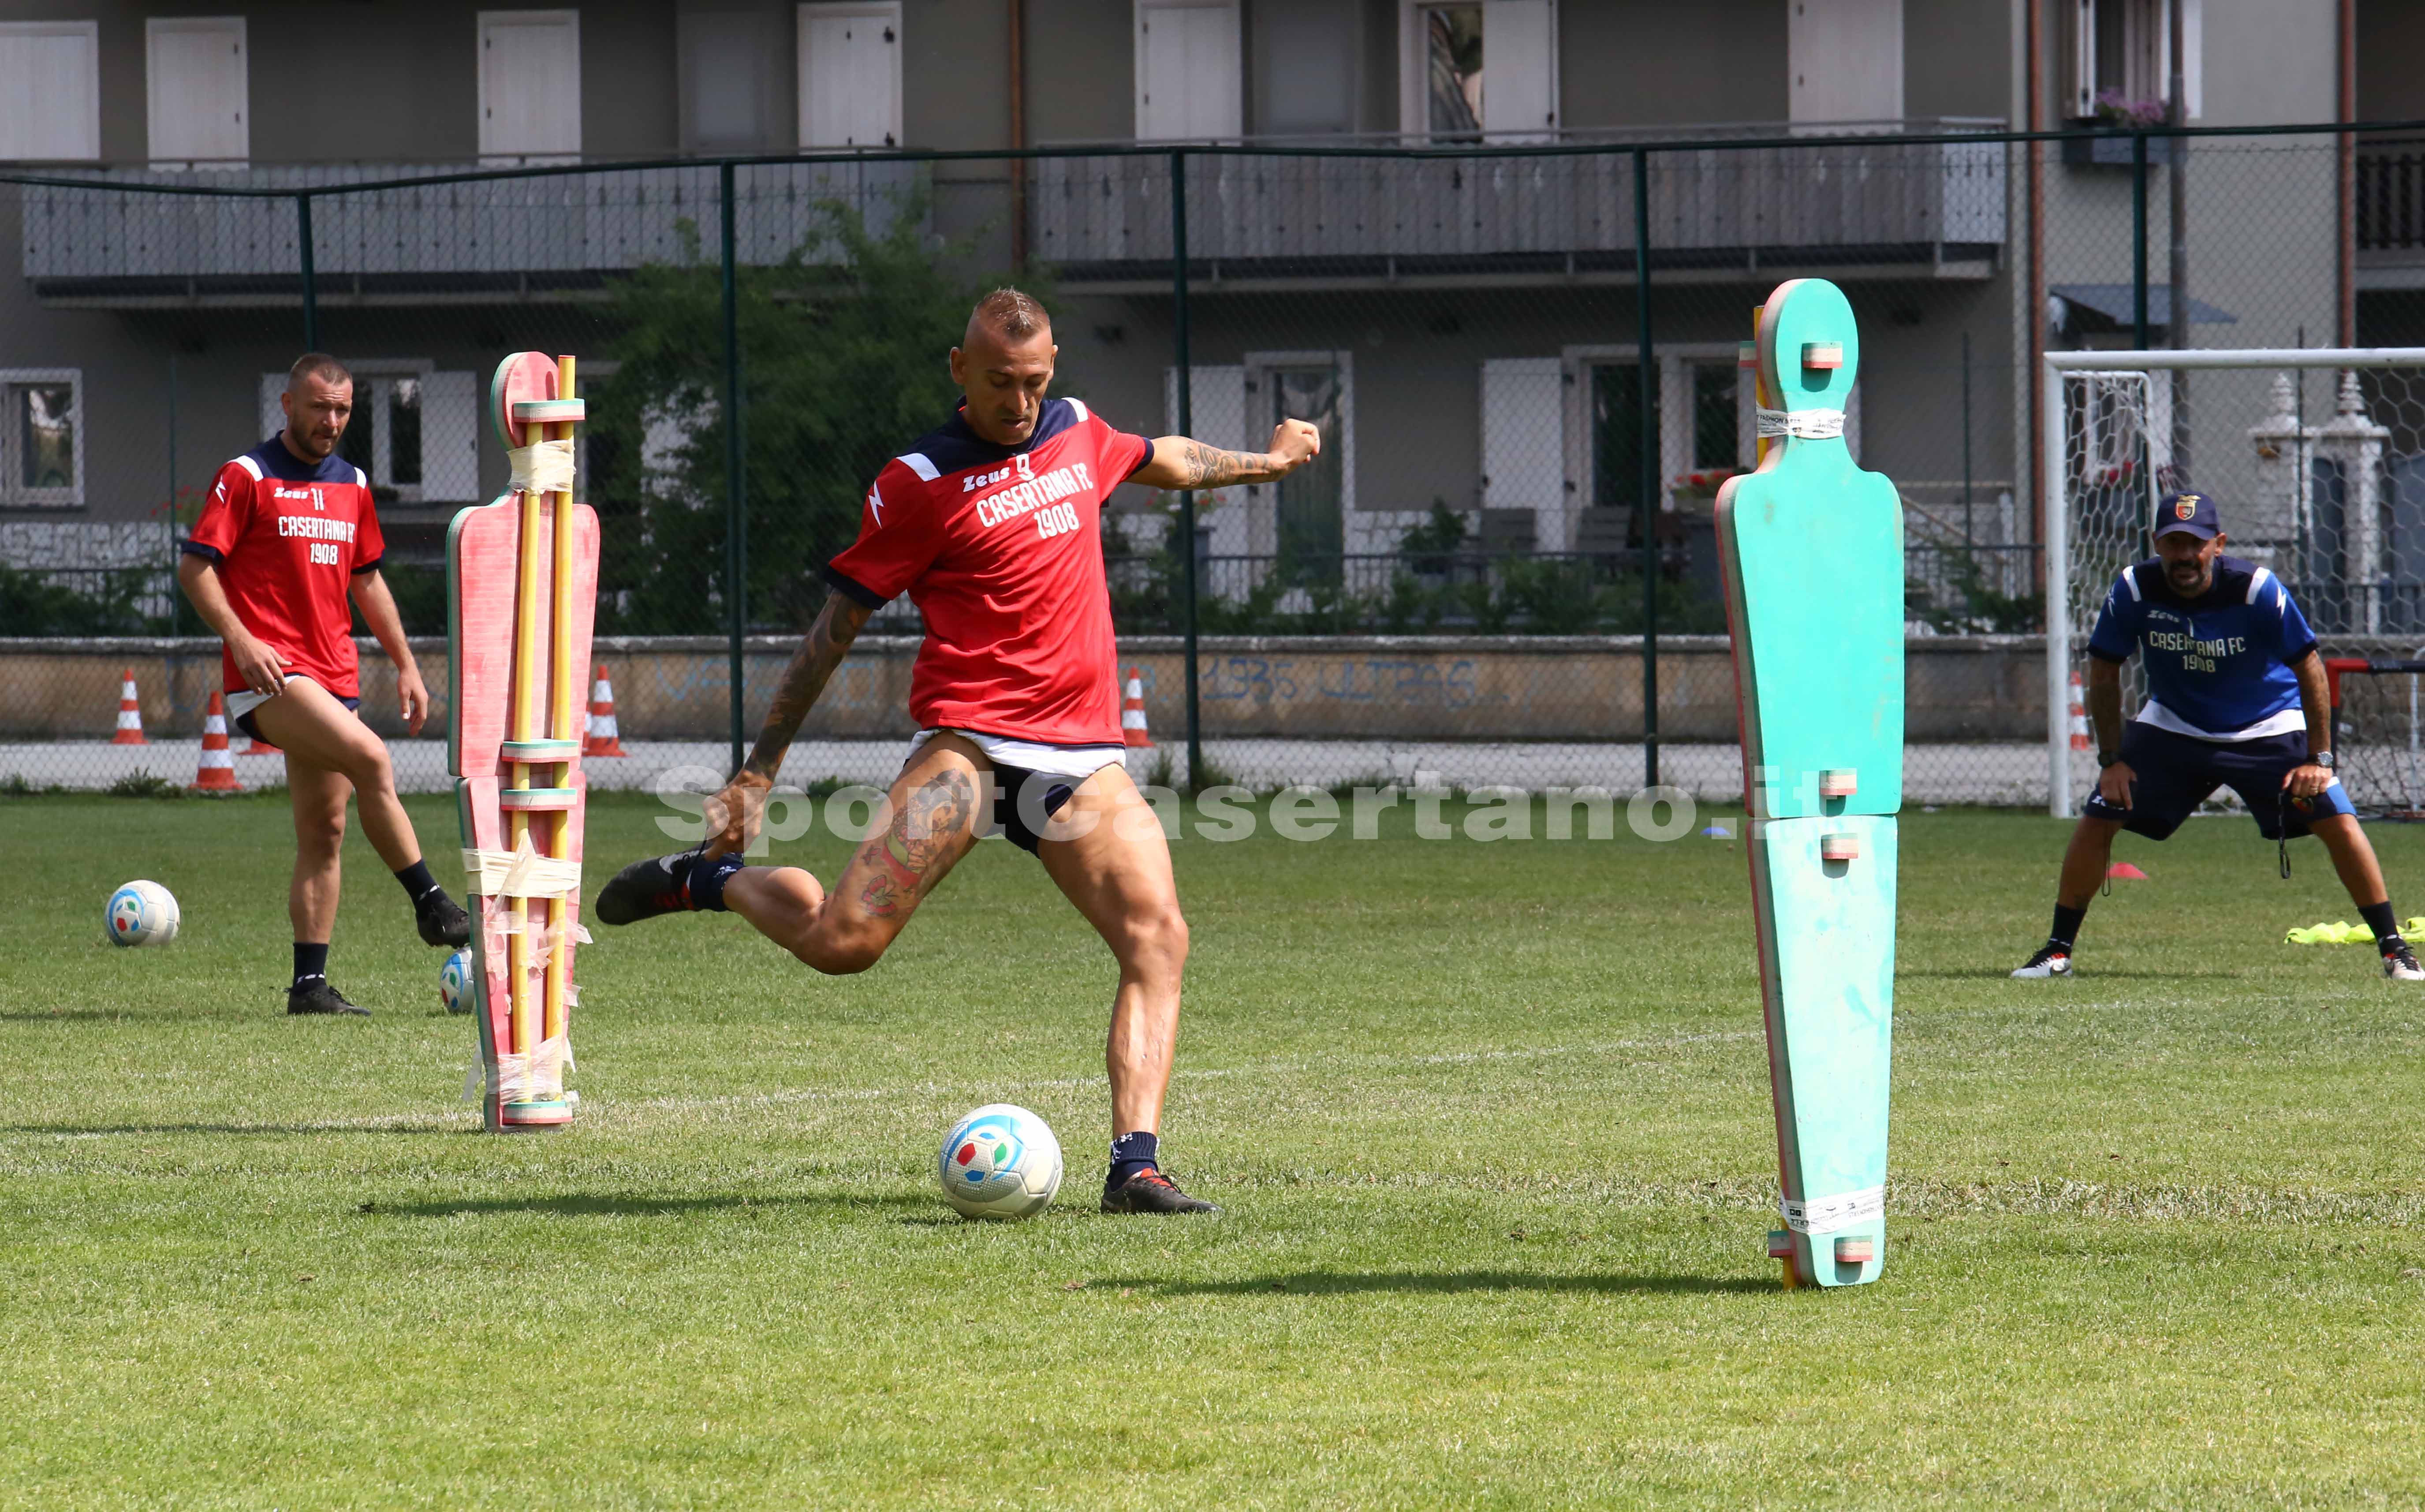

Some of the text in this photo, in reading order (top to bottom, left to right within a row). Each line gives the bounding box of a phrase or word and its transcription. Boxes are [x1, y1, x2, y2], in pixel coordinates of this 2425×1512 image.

[963, 467, 1010, 492] Zeus
[273, 487, 309, 499] Zeus
[976, 462, 1093, 528] CASERTANA FC
[278, 516, 347, 542] CASERTANA
[1034, 502, 1080, 540] 1908
[310, 543, 338, 566] 1908
[2227, 637, 2246, 655] FC
[2182, 654, 2216, 673] 1908
